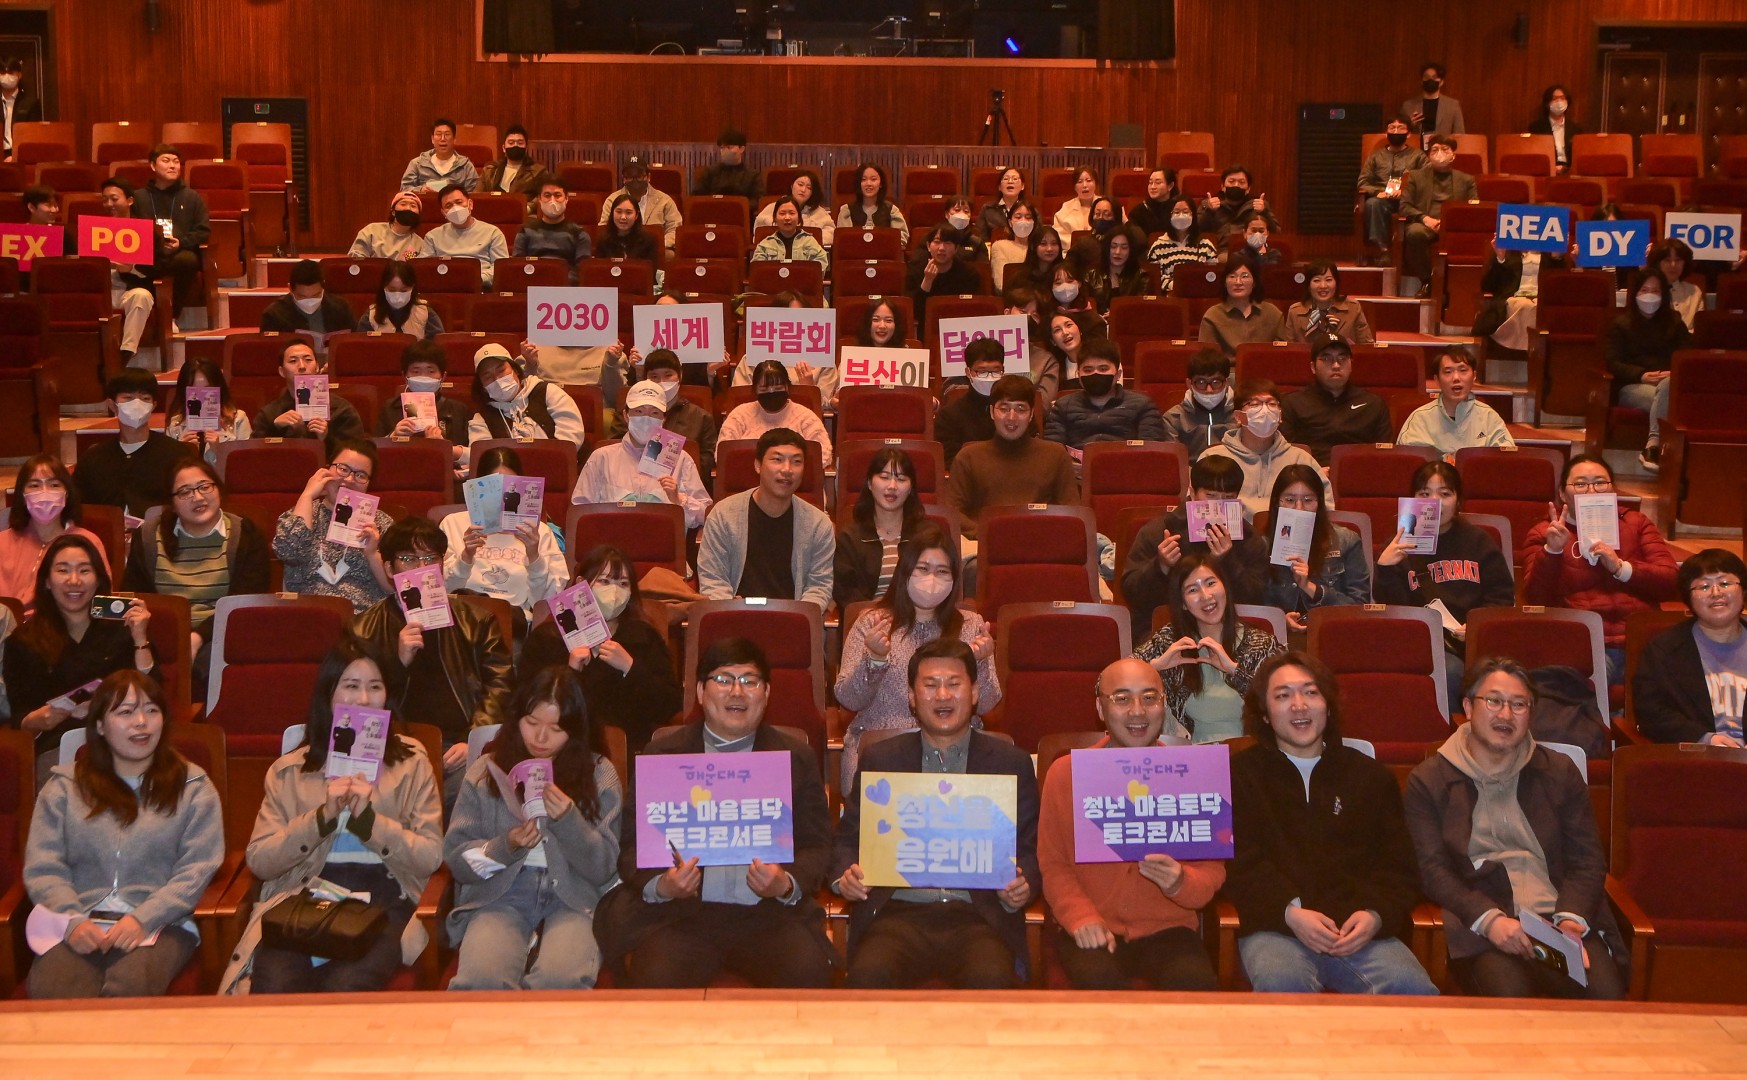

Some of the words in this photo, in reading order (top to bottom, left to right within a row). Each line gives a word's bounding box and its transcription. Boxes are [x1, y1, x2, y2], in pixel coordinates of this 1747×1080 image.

[91, 226, 141, 253] PO
[1498, 214, 1565, 242] REA
[1669, 223, 1735, 249] FOR
[1, 234, 48, 260] EX
[1589, 230, 1636, 257] DY
[536, 302, 610, 331] 2030
[650, 317, 709, 350] 세계
[750, 321, 831, 354] 박람회
[844, 358, 929, 388] 부산이
[679, 763, 751, 786] 해운대구
[1115, 757, 1189, 781] 해운대구
[646, 800, 689, 824] 청년
[696, 797, 783, 822] 마음토닥
[895, 795, 994, 830] 청년을
[1083, 795, 1126, 819] 청년
[1134, 792, 1222, 817] 마음토닥
[665, 824, 772, 850] 토크콘서트
[1103, 819, 1212, 845] 토크콘서트
[895, 837, 993, 874] 응원해
